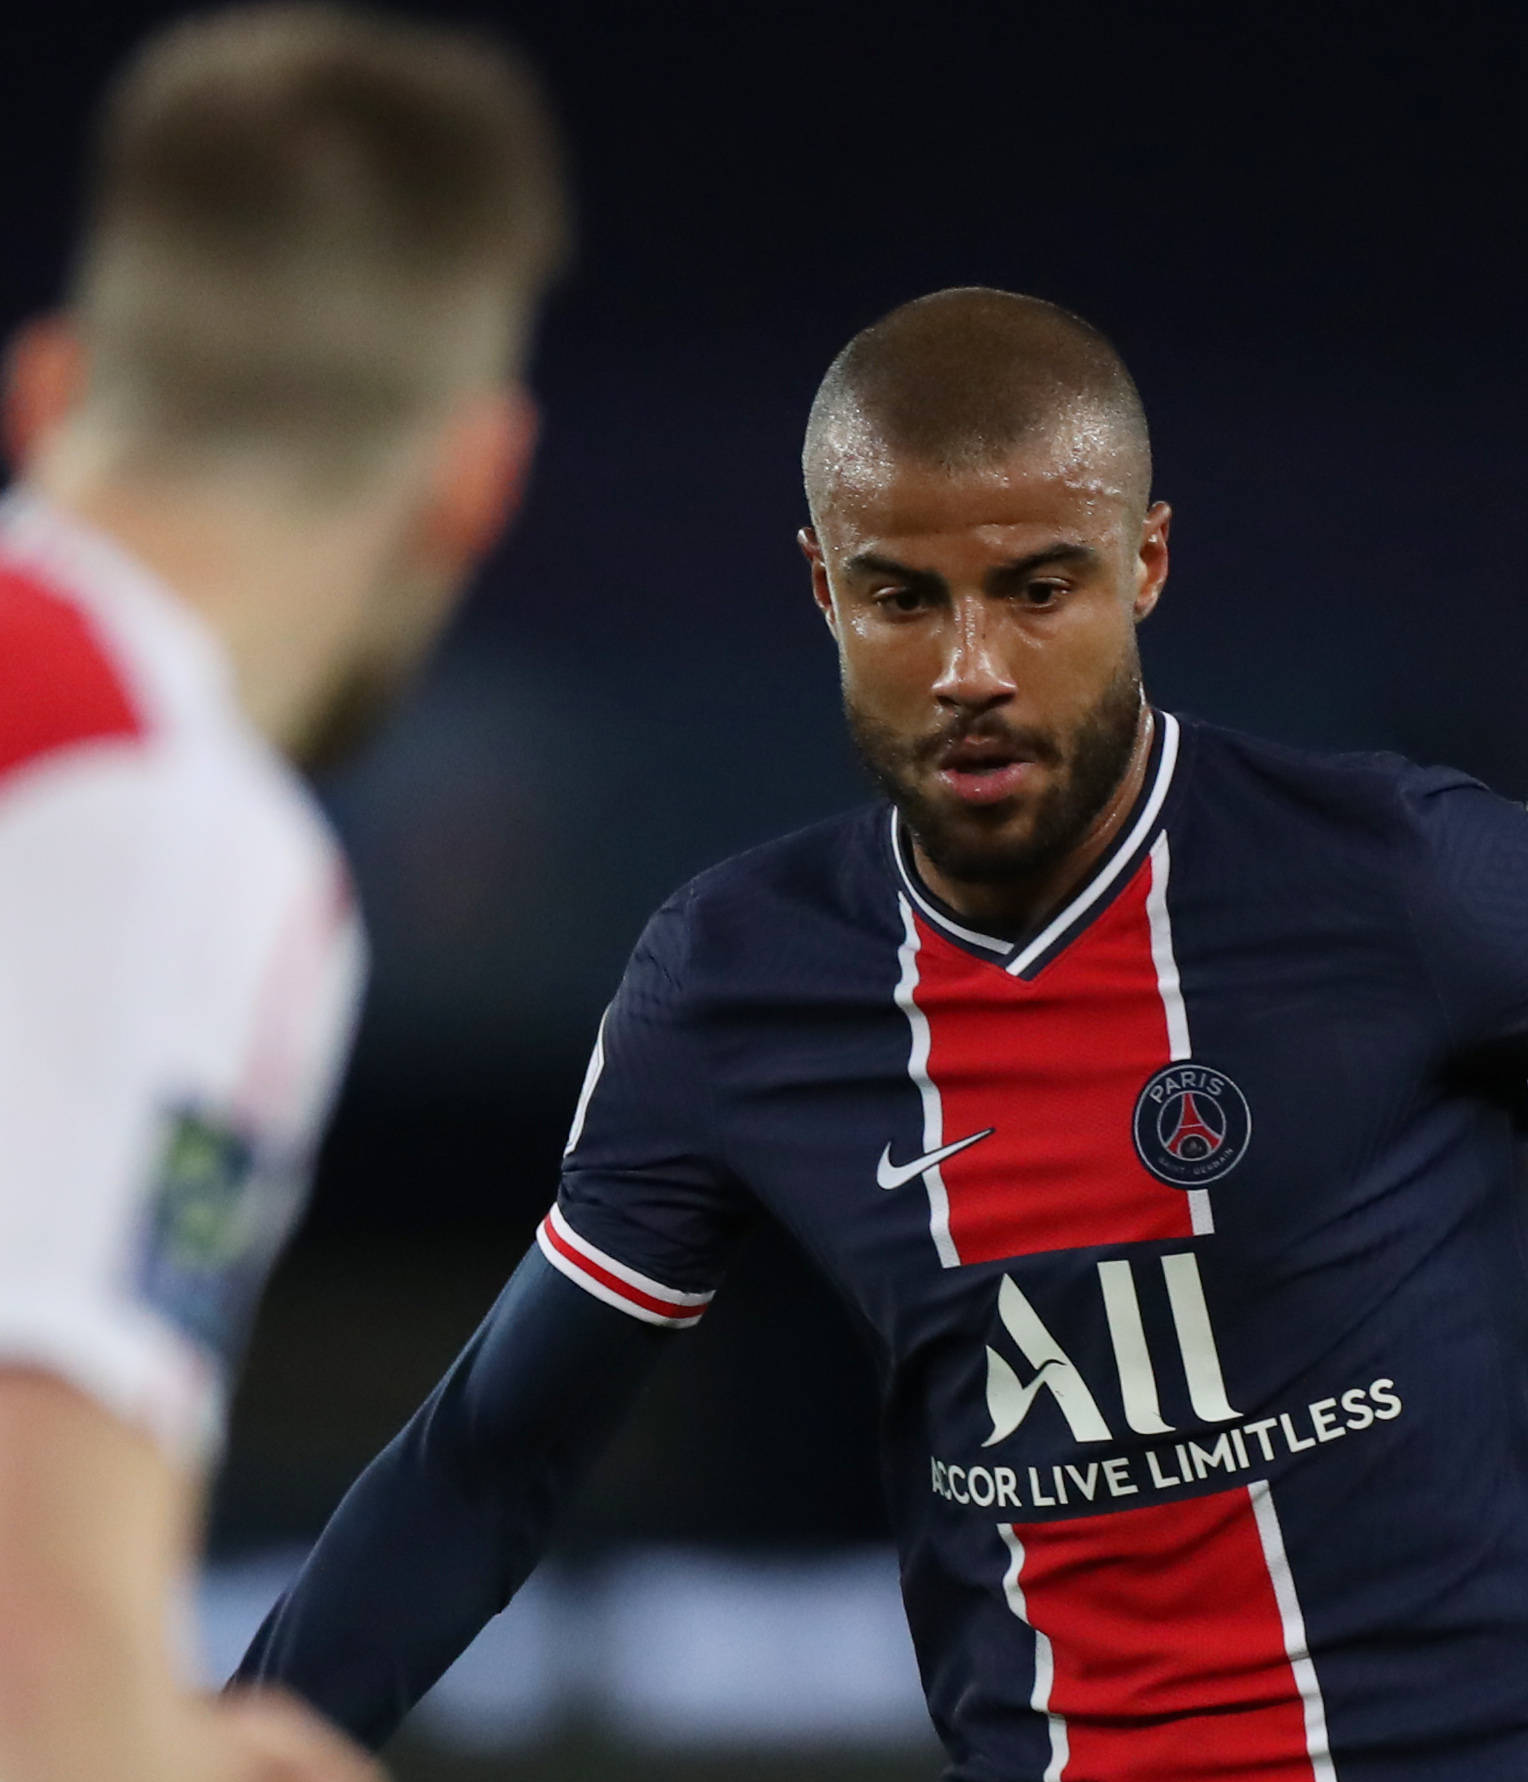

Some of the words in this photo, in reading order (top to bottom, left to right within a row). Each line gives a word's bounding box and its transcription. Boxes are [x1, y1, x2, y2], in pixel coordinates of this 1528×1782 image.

[1149, 1070, 1225, 1105] PARIS
[1028, 1457, 1138, 1507] LIVE
[1144, 1377, 1403, 1489] LIMITLESS
